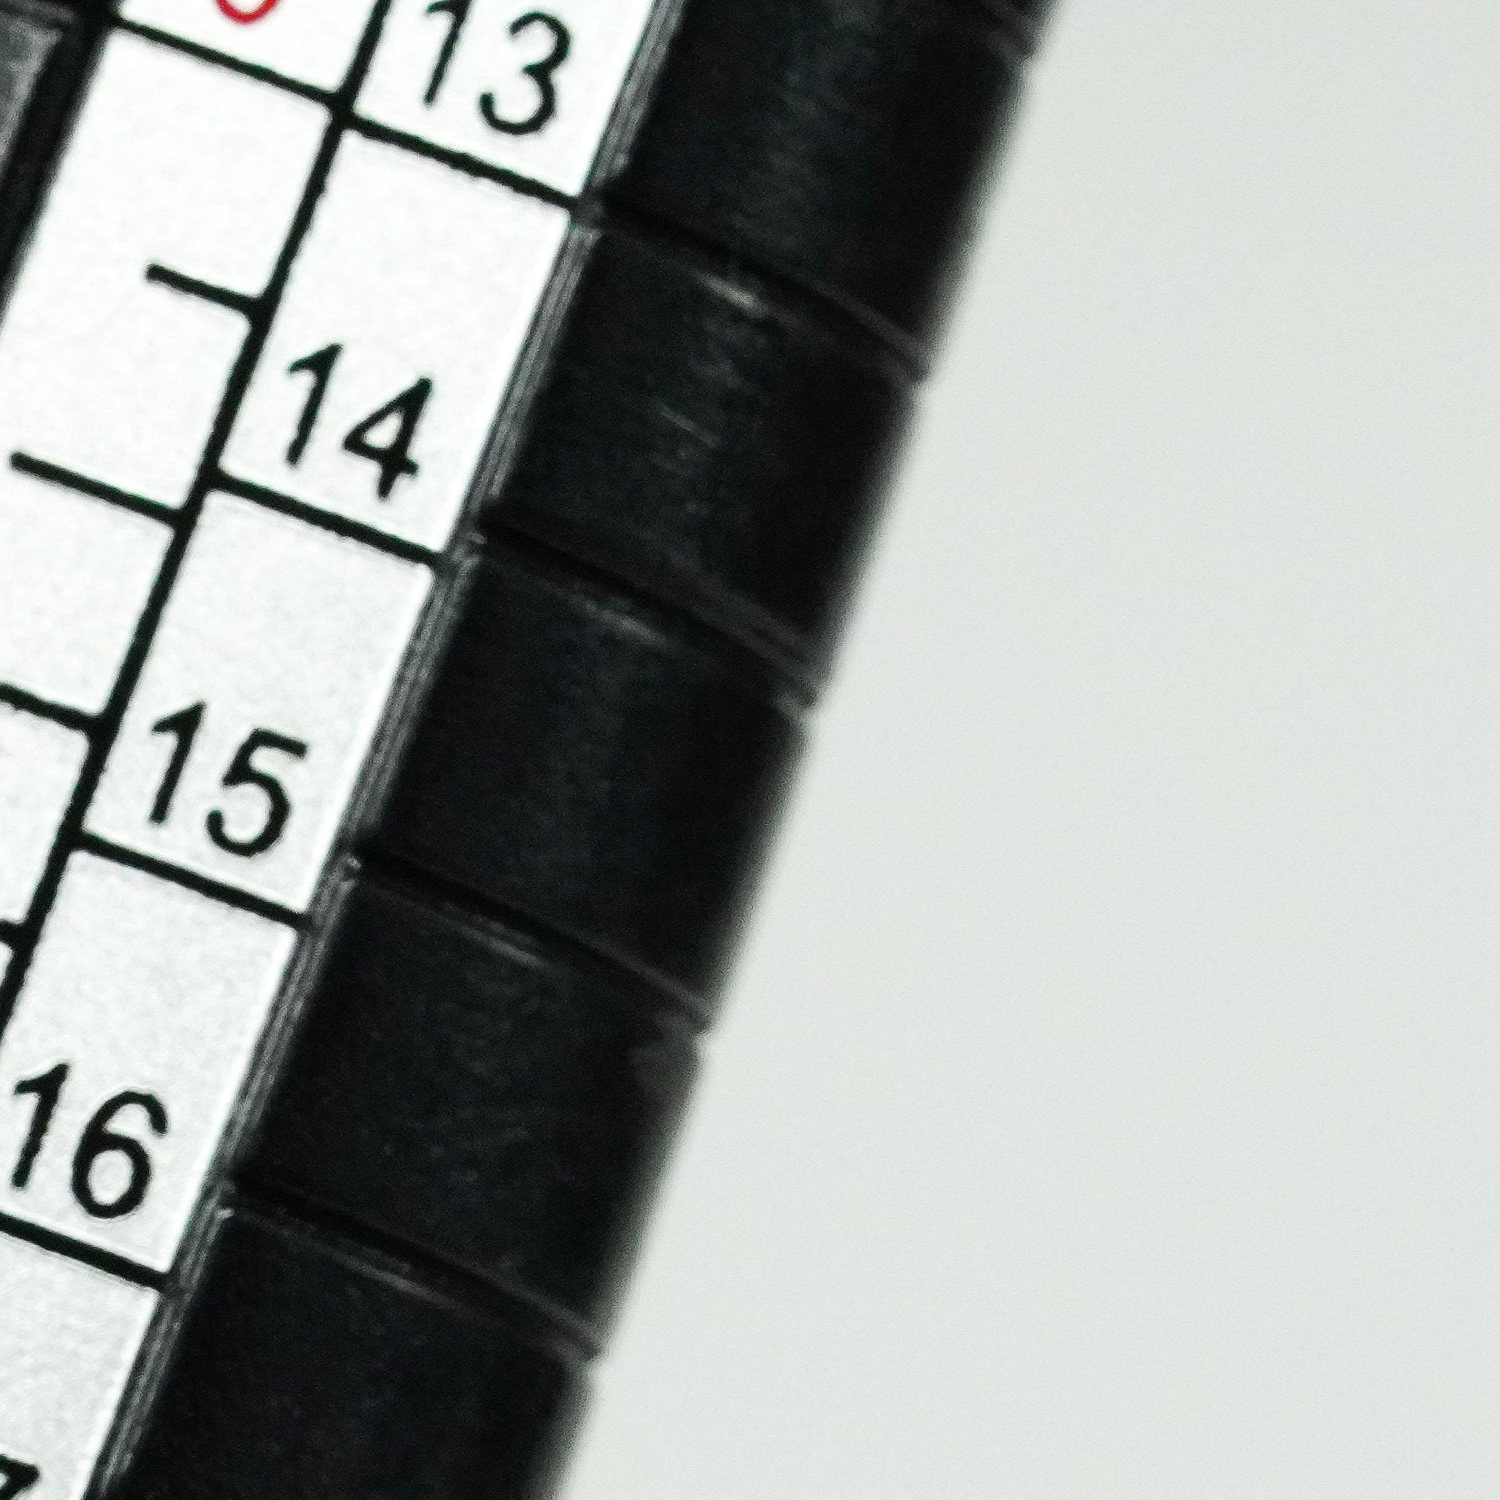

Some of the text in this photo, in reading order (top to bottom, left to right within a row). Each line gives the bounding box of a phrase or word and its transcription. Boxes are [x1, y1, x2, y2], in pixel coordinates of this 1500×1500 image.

[424, 0, 572, 136] 13
[285, 343, 433, 499] 14
[149, 702, 308, 858] 15
[11, 1063, 168, 1220] 16
